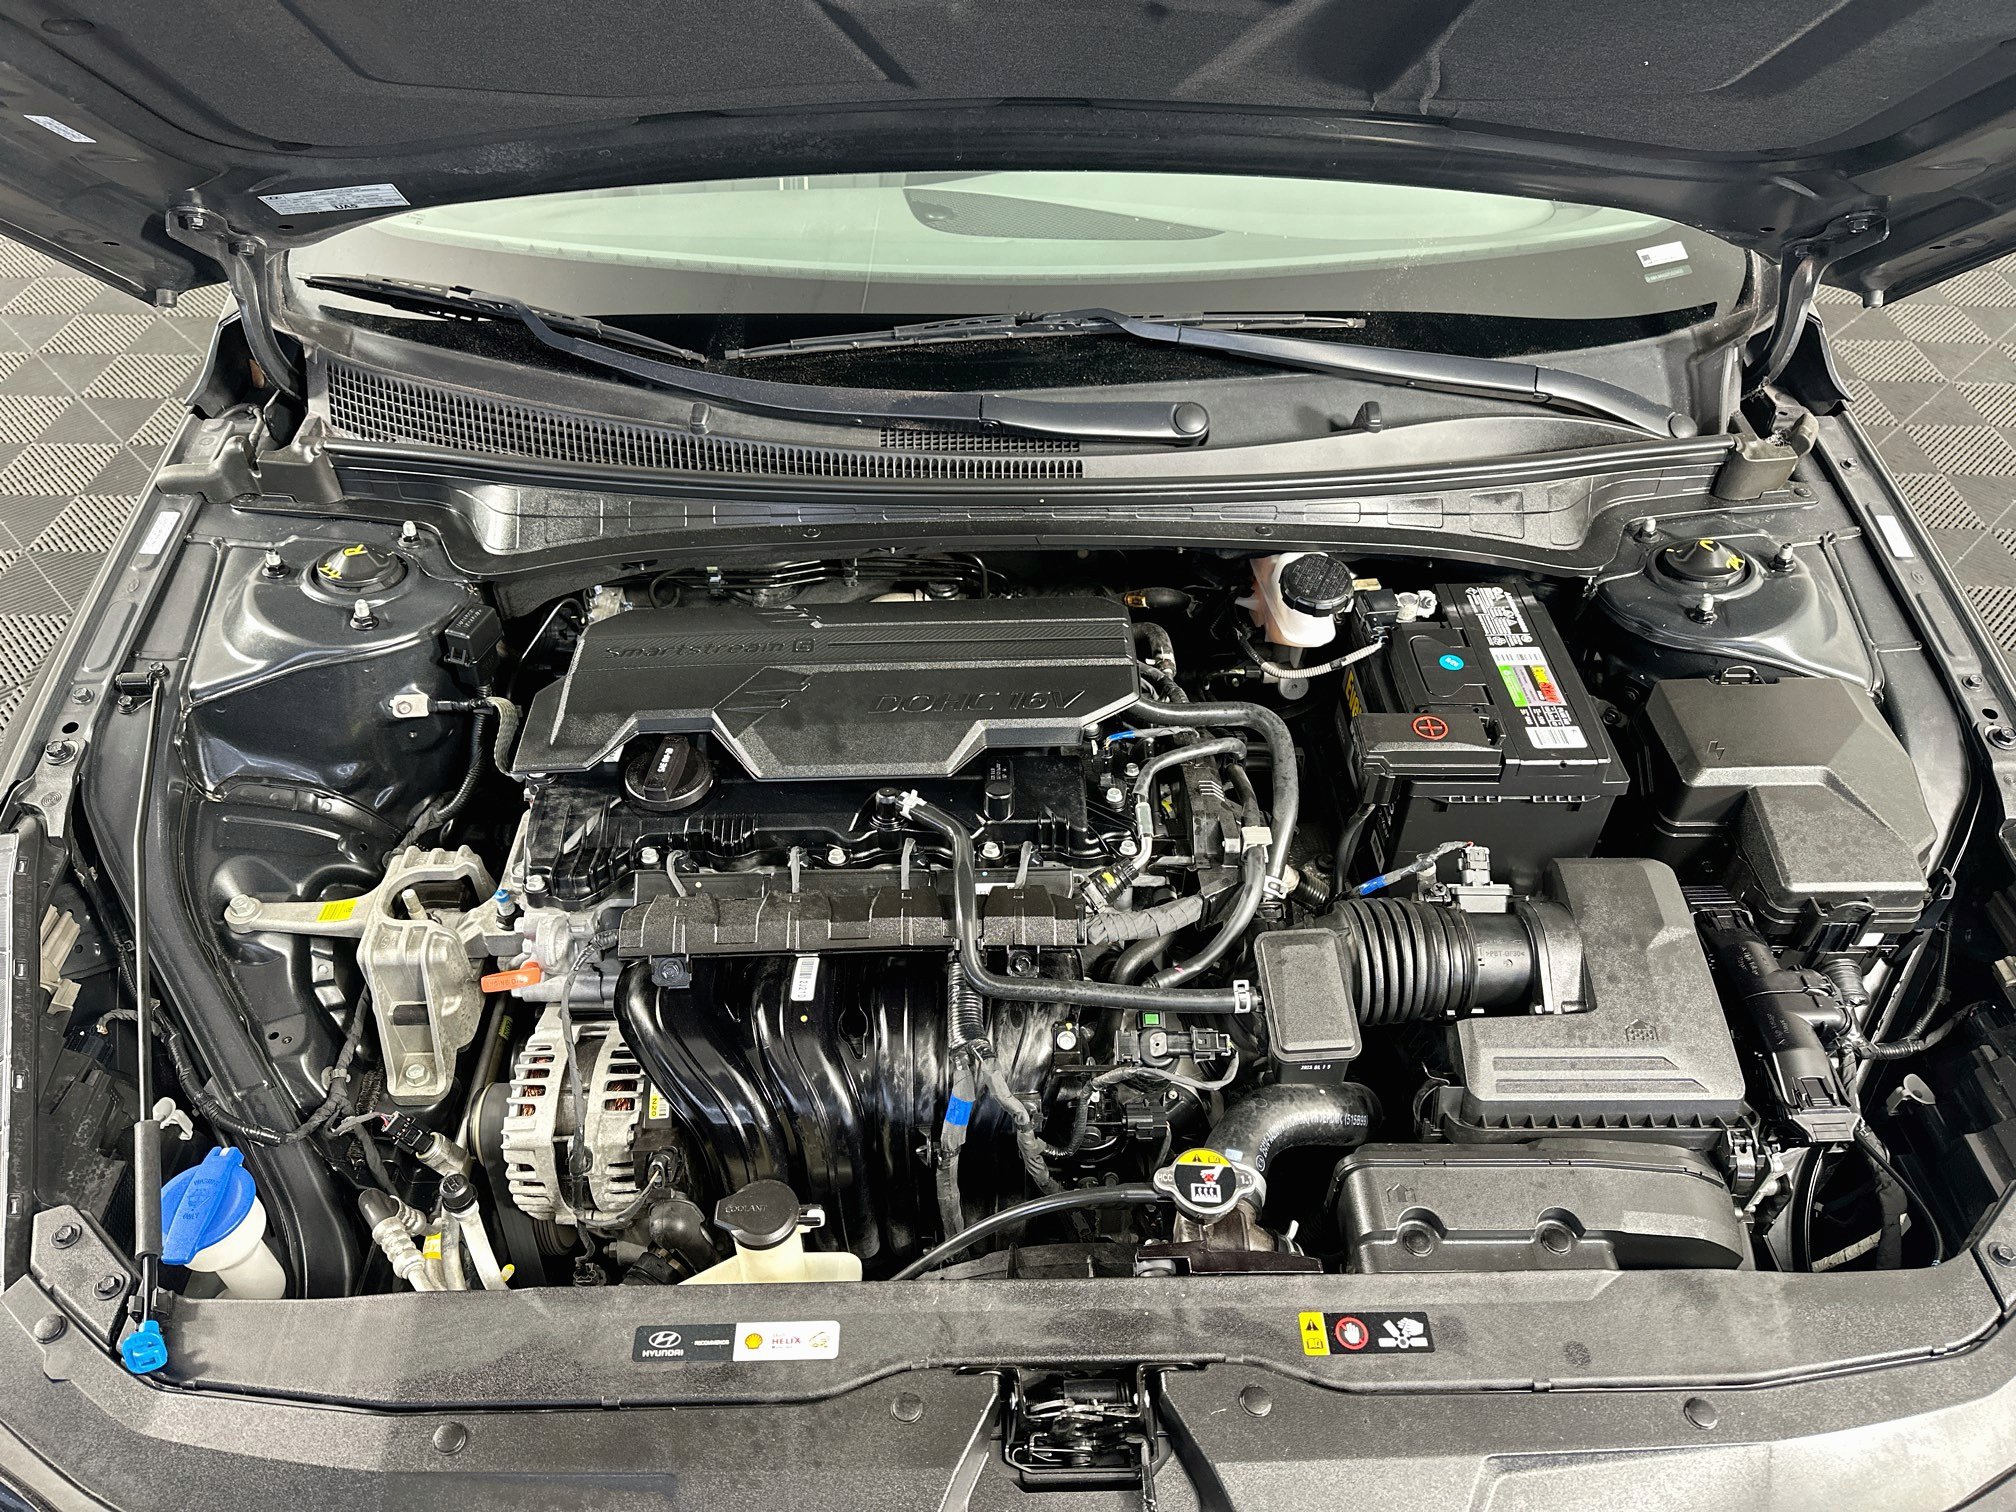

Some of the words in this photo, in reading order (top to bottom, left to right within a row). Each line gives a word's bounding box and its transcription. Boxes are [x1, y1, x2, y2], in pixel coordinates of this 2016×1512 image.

[605, 641, 786, 658] Smartstream
[868, 691, 1001, 714] DOHC
[1009, 689, 1085, 711] 16V
[1157, 1173, 1174, 1183] HCC
[1240, 1175, 1253, 1185] 1.1
[725, 1204, 768, 1213] COOLANT
[771, 1336, 801, 1345] HELIX
[642, 1349, 684, 1357] HYUNDAI
